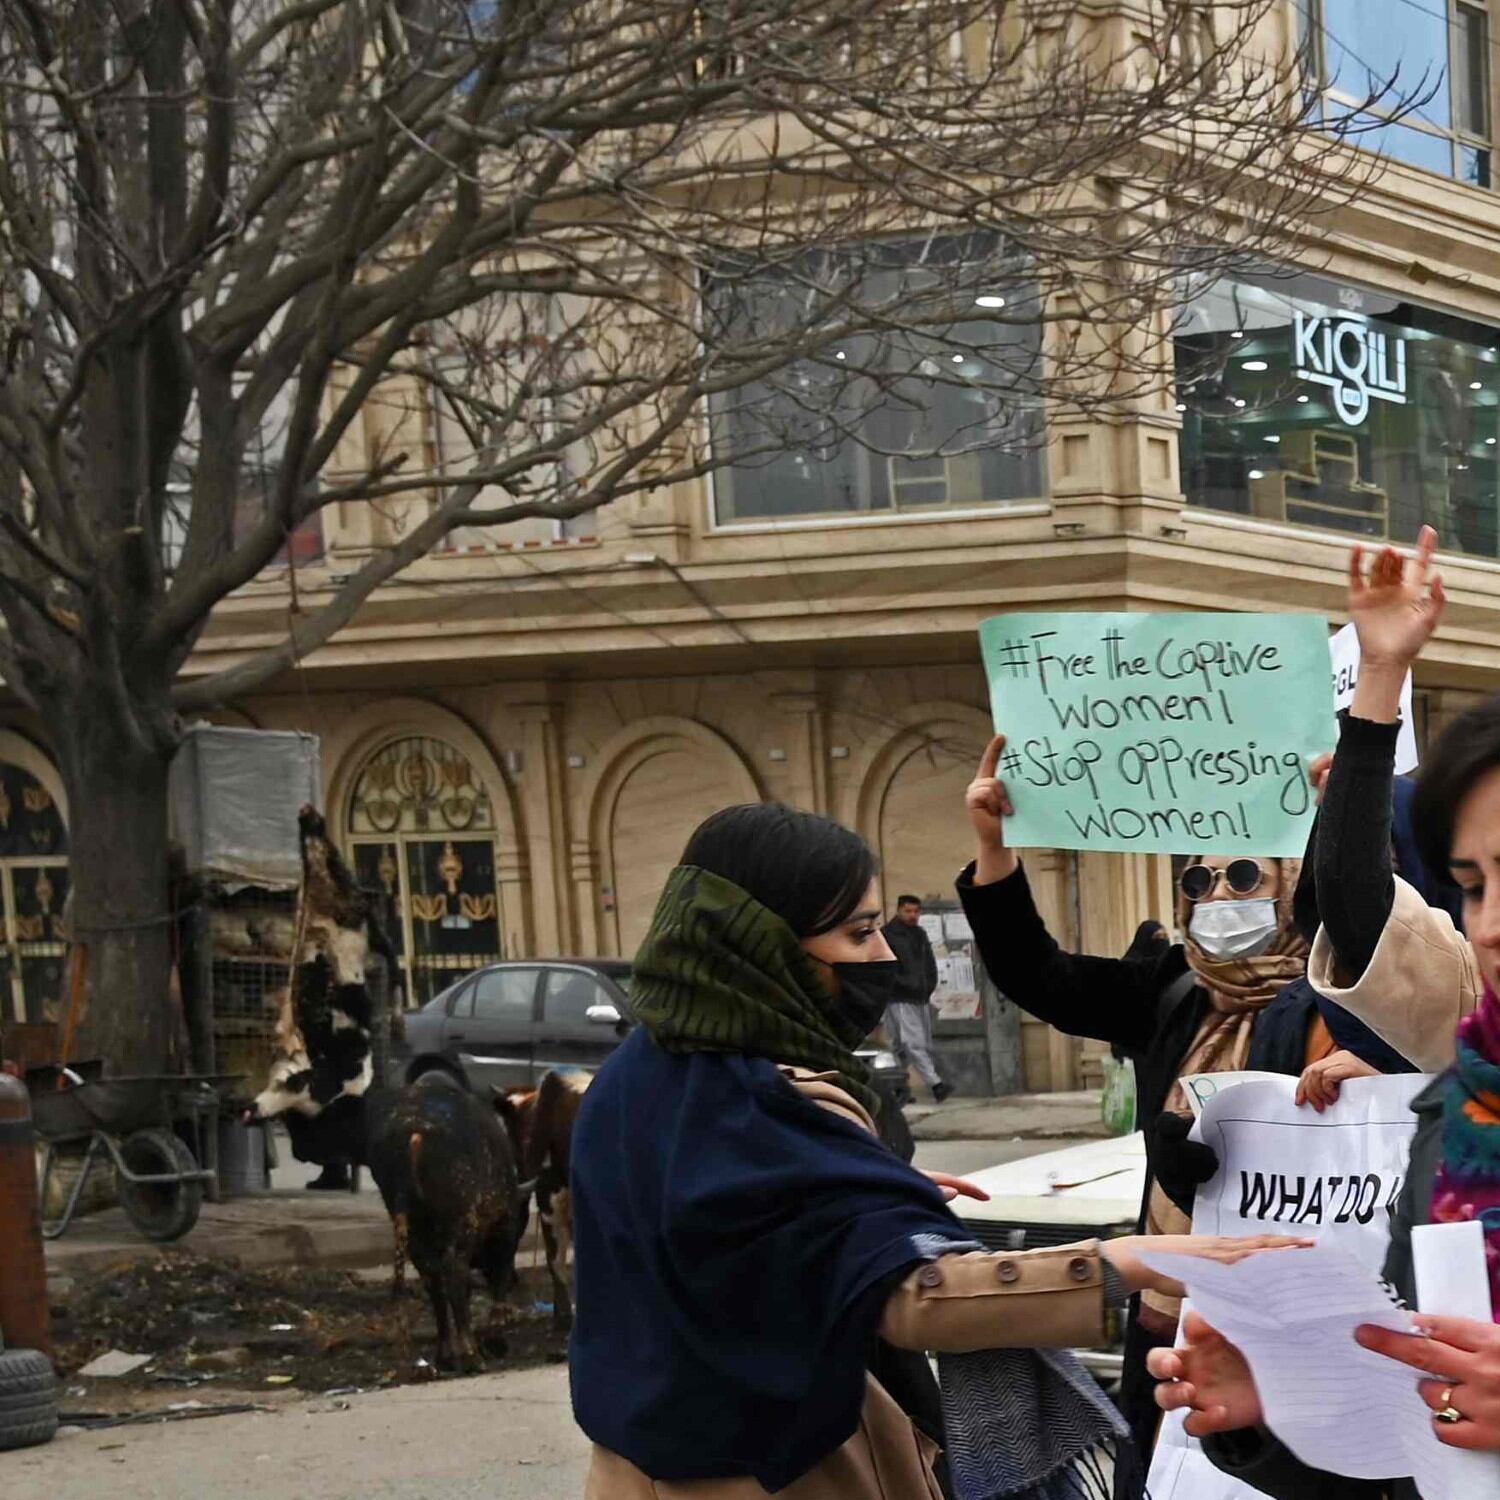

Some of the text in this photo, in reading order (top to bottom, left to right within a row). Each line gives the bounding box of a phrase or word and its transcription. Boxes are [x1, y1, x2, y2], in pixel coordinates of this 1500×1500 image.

[1000, 630, 1096, 695] #Free
[1239, 1170, 1344, 1225] WHAT
[1334, 1173, 1382, 1225] DO
